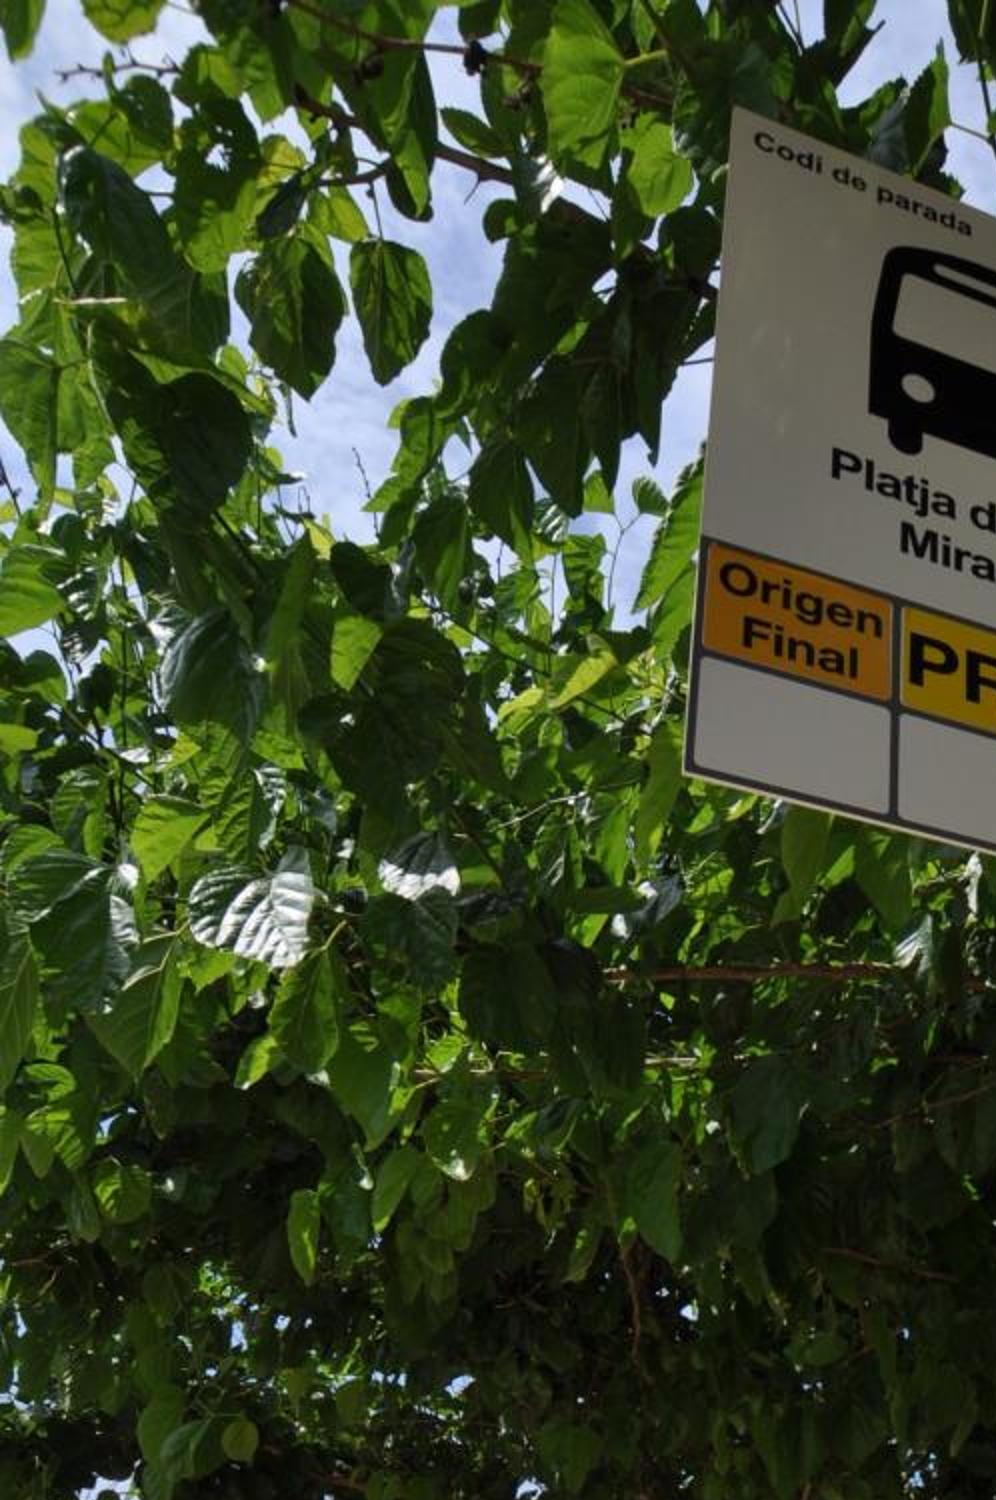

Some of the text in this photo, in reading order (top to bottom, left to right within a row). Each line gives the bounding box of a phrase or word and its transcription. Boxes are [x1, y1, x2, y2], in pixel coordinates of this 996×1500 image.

[753, 130, 974, 238] Codi de parada
[830, 446, 957, 520] Platja
[719, 561, 885, 638] Origen
[742, 615, 859, 680] Final
